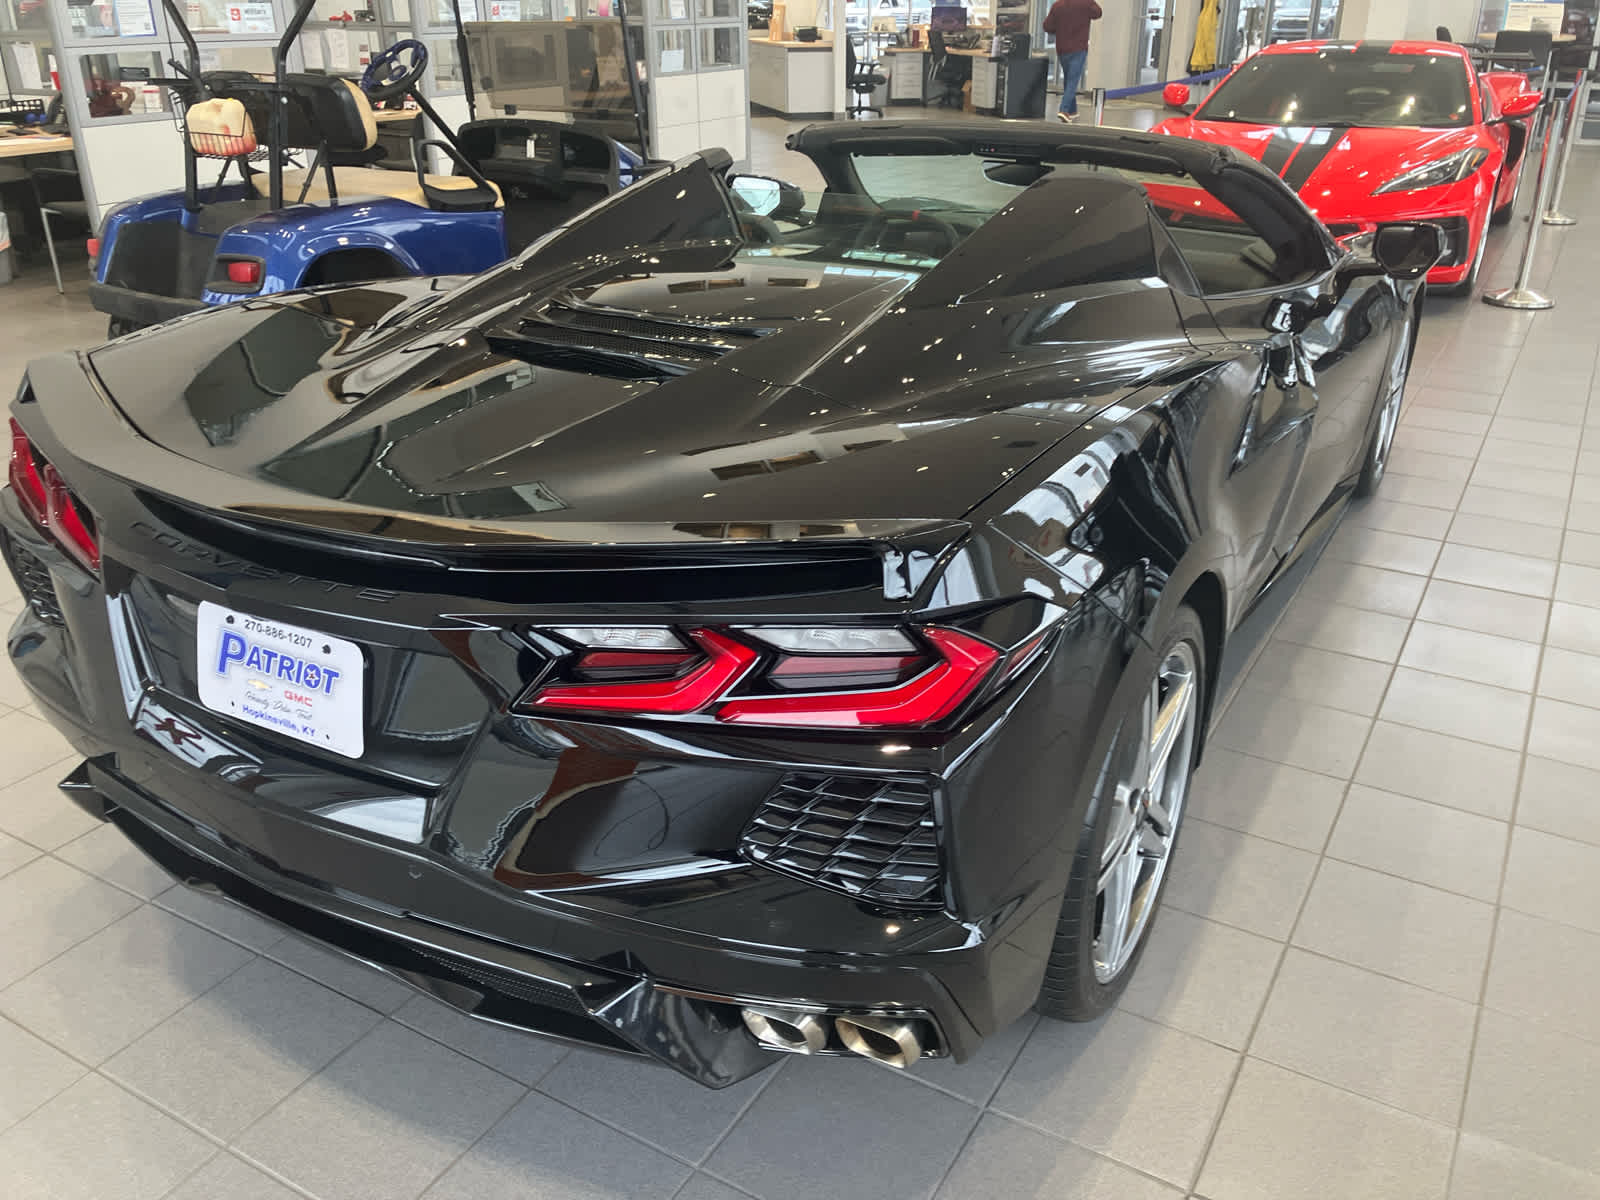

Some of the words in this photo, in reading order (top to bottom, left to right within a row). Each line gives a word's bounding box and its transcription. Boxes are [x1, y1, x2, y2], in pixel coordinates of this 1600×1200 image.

[129, 521, 401, 603] CORVETTE
[244, 619, 313, 648] 270-886-1207
[217, 631, 341, 694] PATRIOT
[284, 690, 313, 707] GMC
[301, 726, 316, 736] KY
